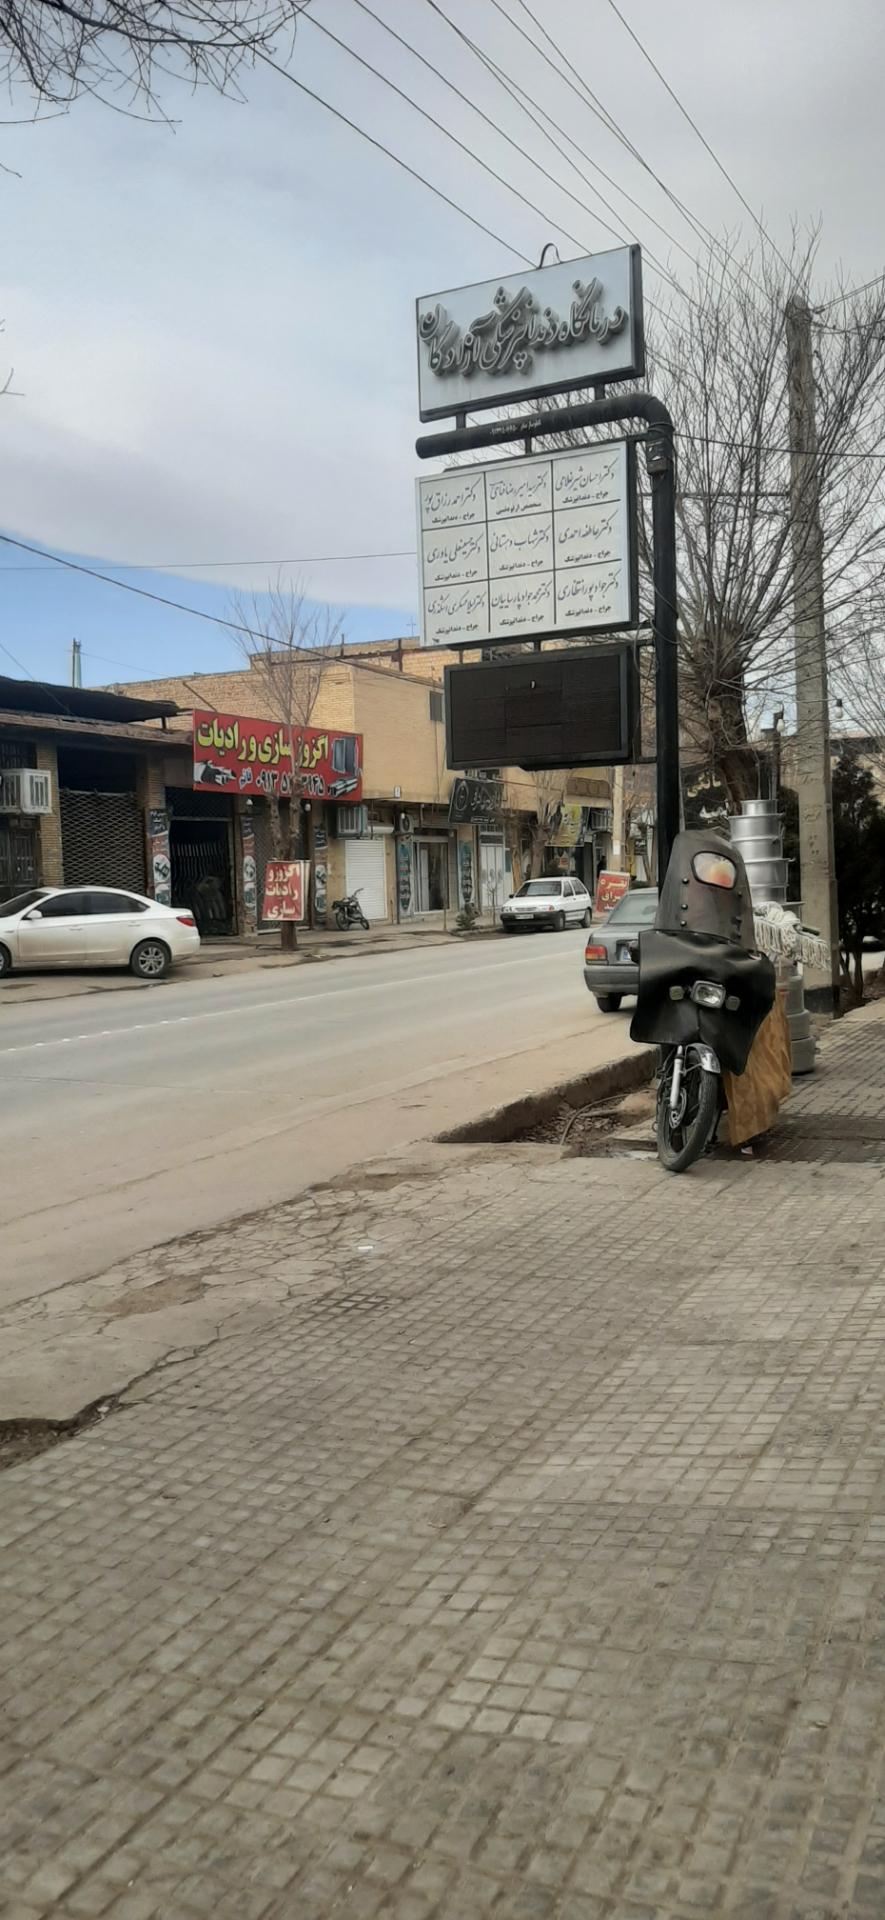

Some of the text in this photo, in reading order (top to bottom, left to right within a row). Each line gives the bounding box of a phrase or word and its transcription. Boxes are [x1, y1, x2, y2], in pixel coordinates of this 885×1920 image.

[418, 277, 626, 374] درمانگاه دندانپزشکی آزادگان
[598, 457, 619, 484] دکتر
[461, 477, 482, 506] دکتر
[596, 491, 609, 499] جراح
[463, 512, 475, 520] جراح
[595, 509, 619, 540] دکتر
[559, 527, 582, 544] احمدی
[427, 547, 449, 564] یاوری
[531, 559, 543, 567] جراح
[597, 551, 611, 559] جراح
[465, 569, 478, 577] جراح
[531, 613, 544, 623] جراح
[598, 605, 611, 614] جراح
[466, 623, 479, 632] جراح
[197, 717, 245, 761] رادیات
[257, 728, 292, 765] سازی
[267, 900, 296, 920] سازی
